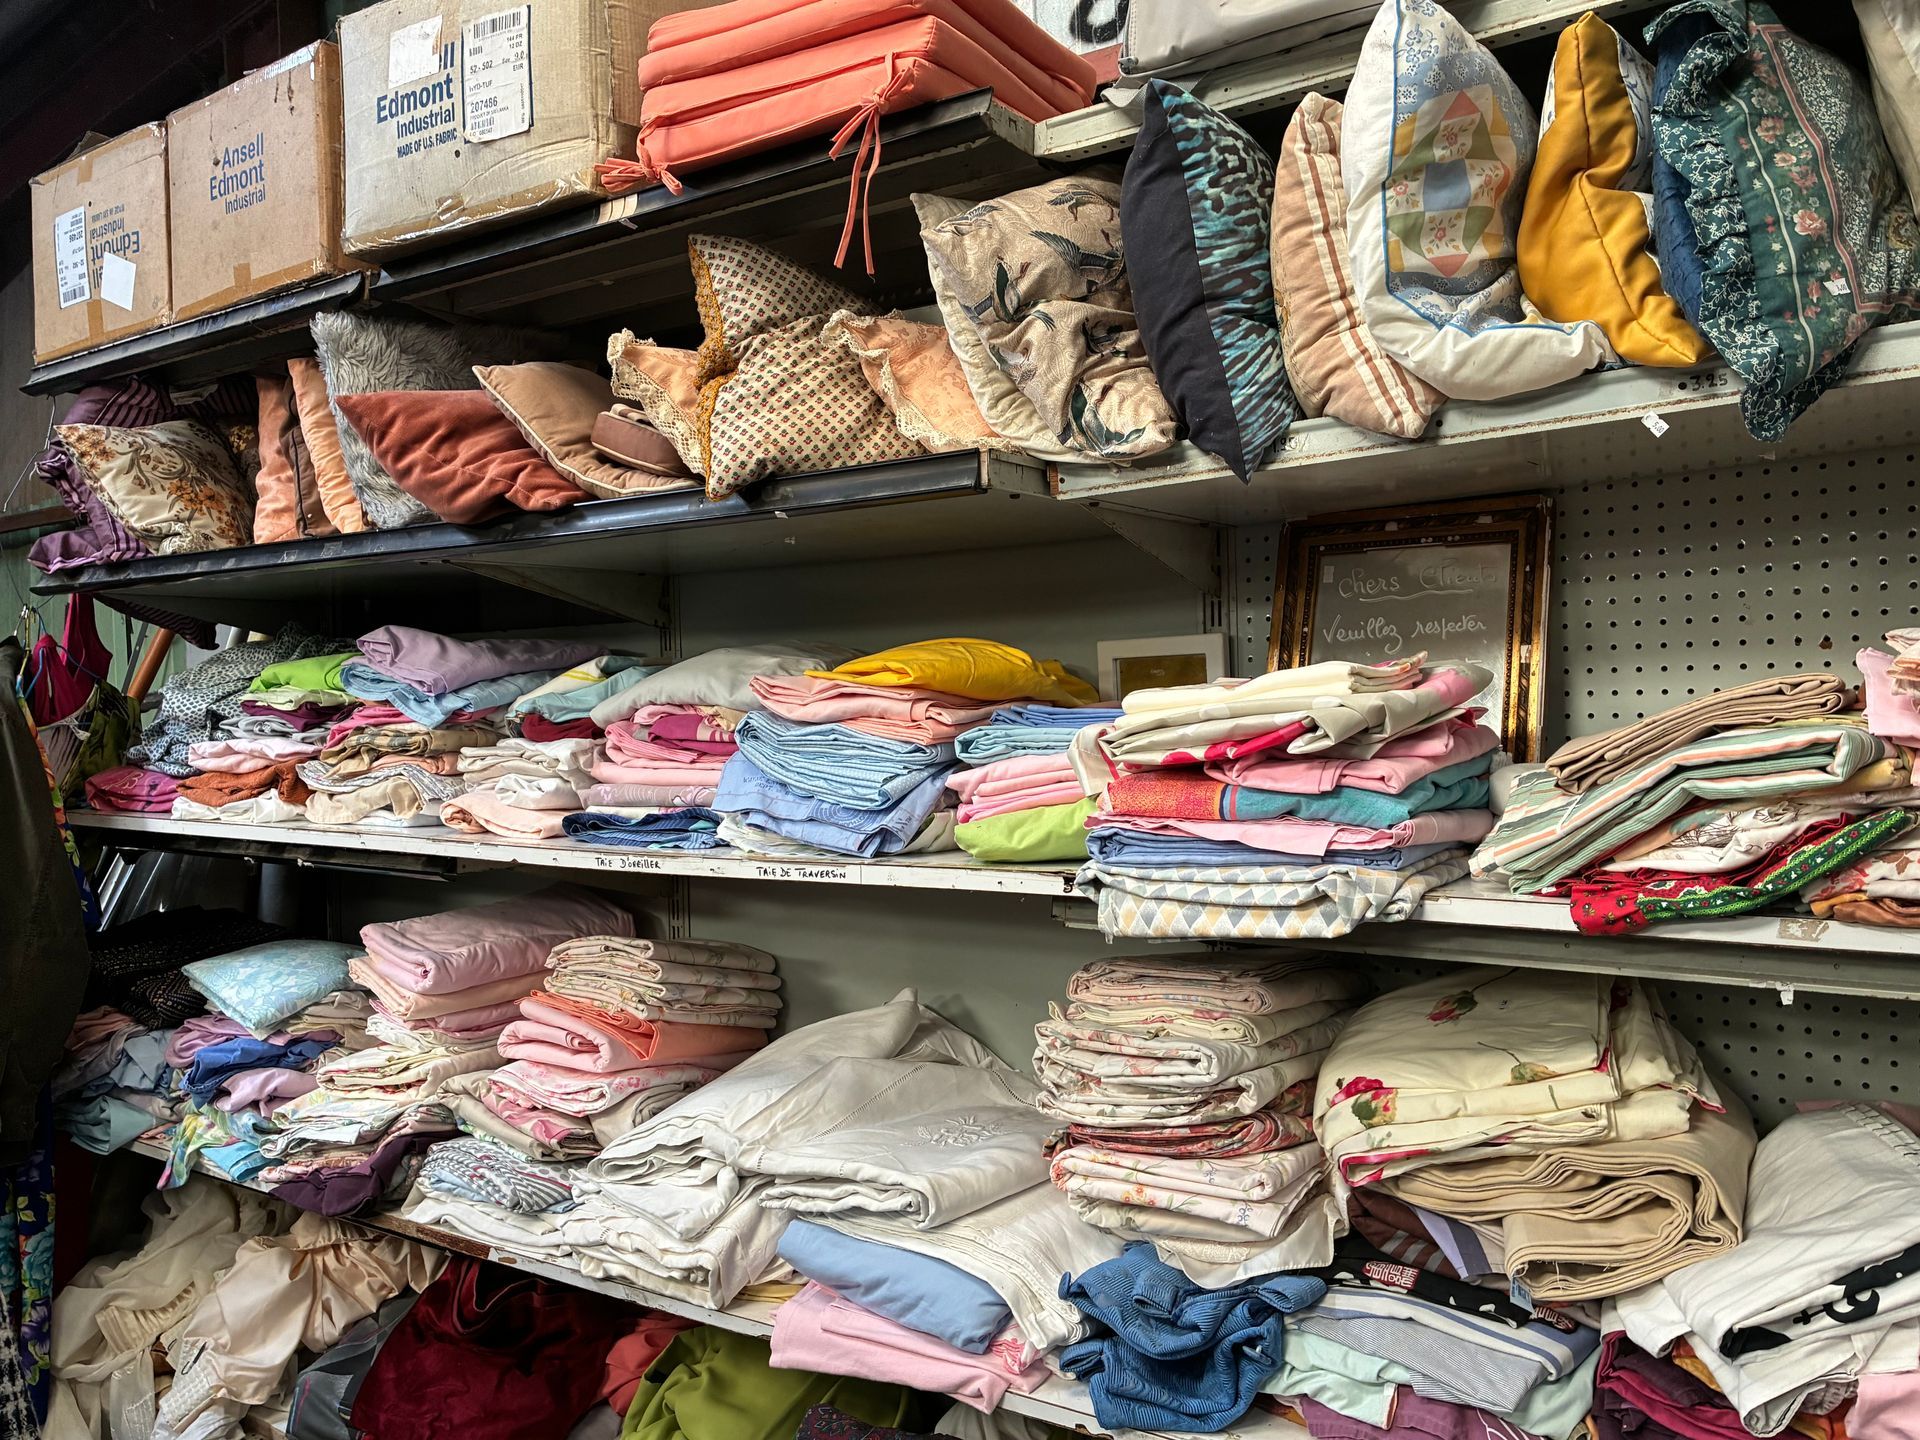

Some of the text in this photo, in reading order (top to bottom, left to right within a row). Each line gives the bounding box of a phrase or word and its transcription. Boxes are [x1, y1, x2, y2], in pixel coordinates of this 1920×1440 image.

[377, 73, 454, 124] Edmont
[397, 102, 455, 139] Industrial
[222, 132, 264, 171] Ansell
[397, 142, 413, 159] MADE
[414, 139, 422, 152] OF
[435, 128, 458, 146] FABRIC
[209, 159, 265, 201] Edmont
[225, 184, 266, 215] Industrial
[89, 217, 125, 245] Industrial
[1689, 373, 1729, 392] 3.25
[1411, 614, 1488, 640] respecter
[780, 867, 792, 878] DE
